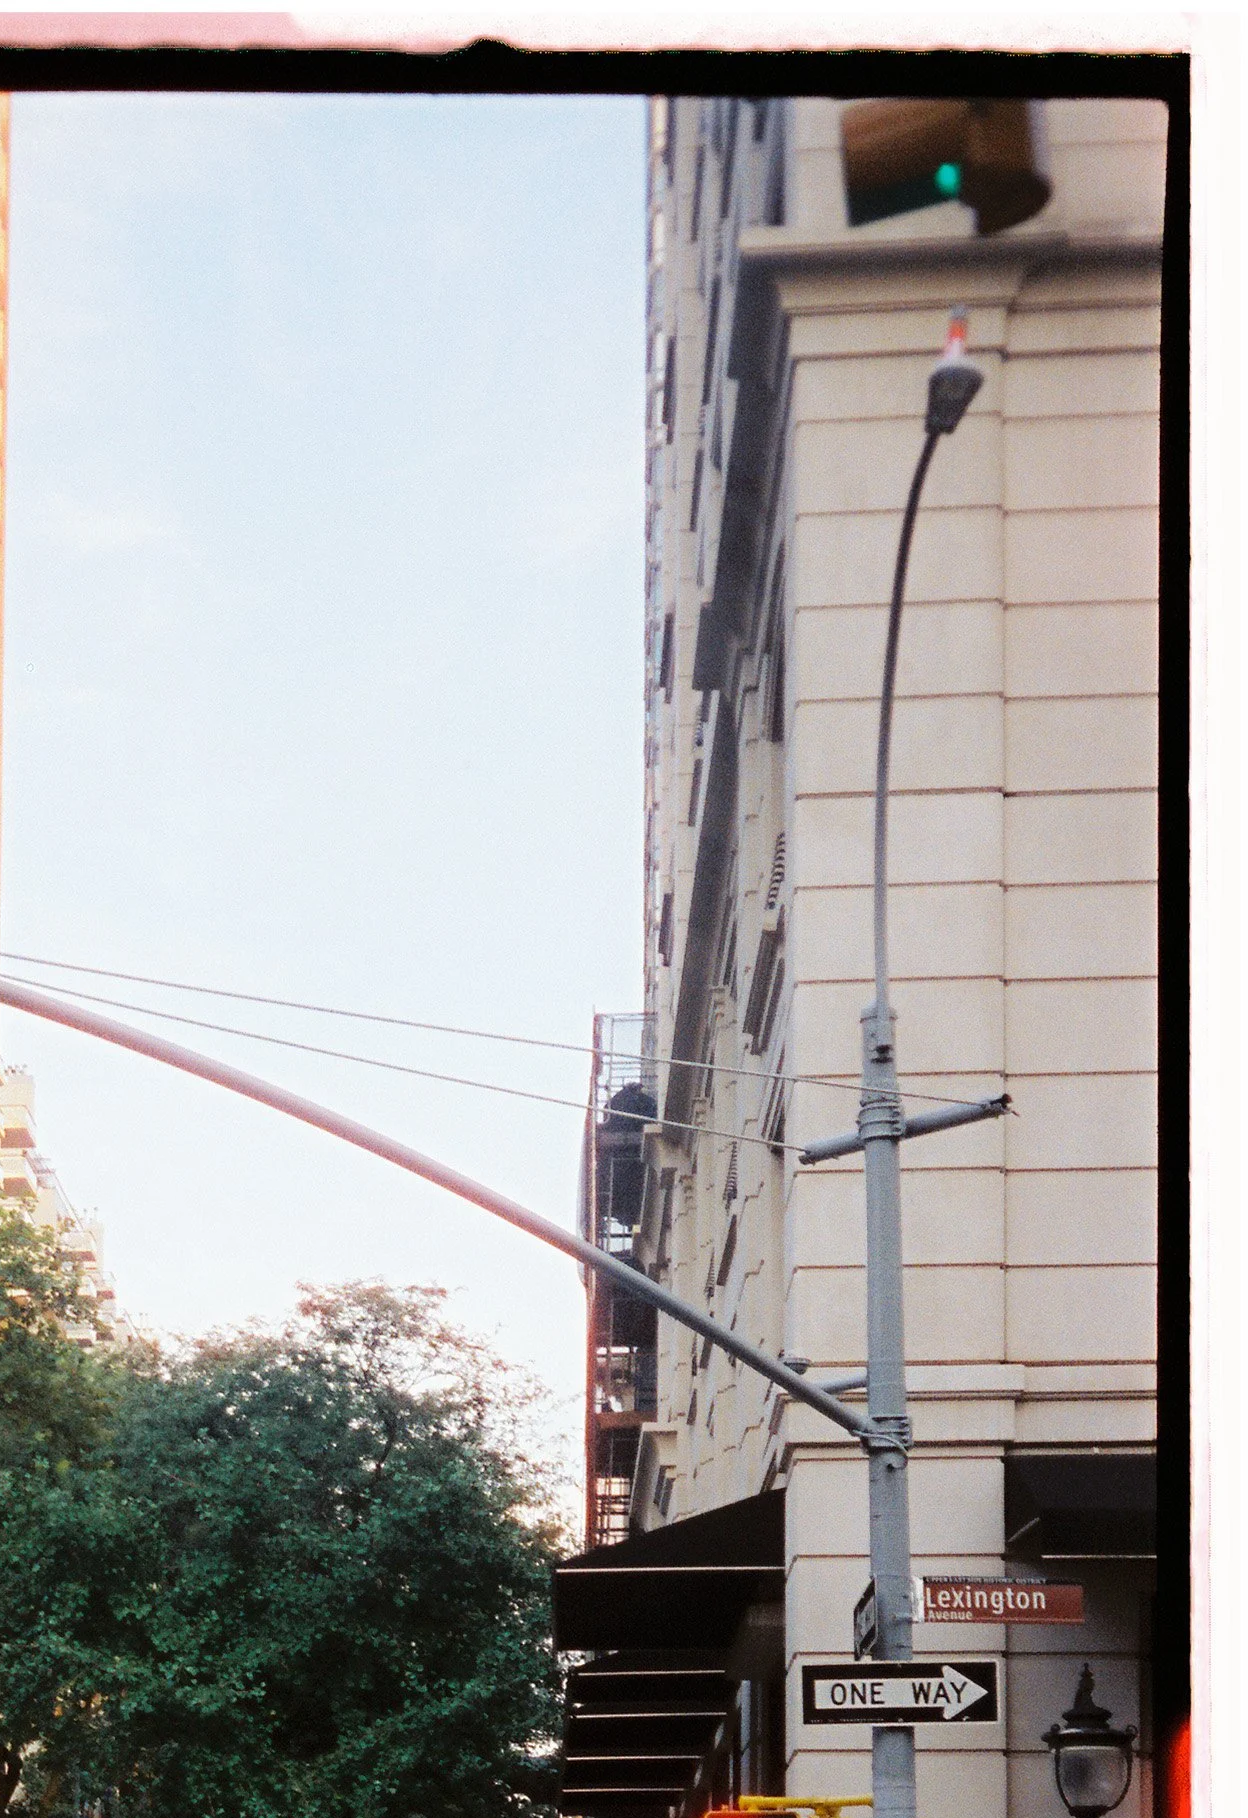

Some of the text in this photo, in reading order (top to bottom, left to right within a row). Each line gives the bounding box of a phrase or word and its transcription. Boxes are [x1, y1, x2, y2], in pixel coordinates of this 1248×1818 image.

[925, 1585, 1046, 1615] Lexington
[927, 1609, 973, 1620] Avenue
[830, 1681, 968, 1706] ONE WAY
